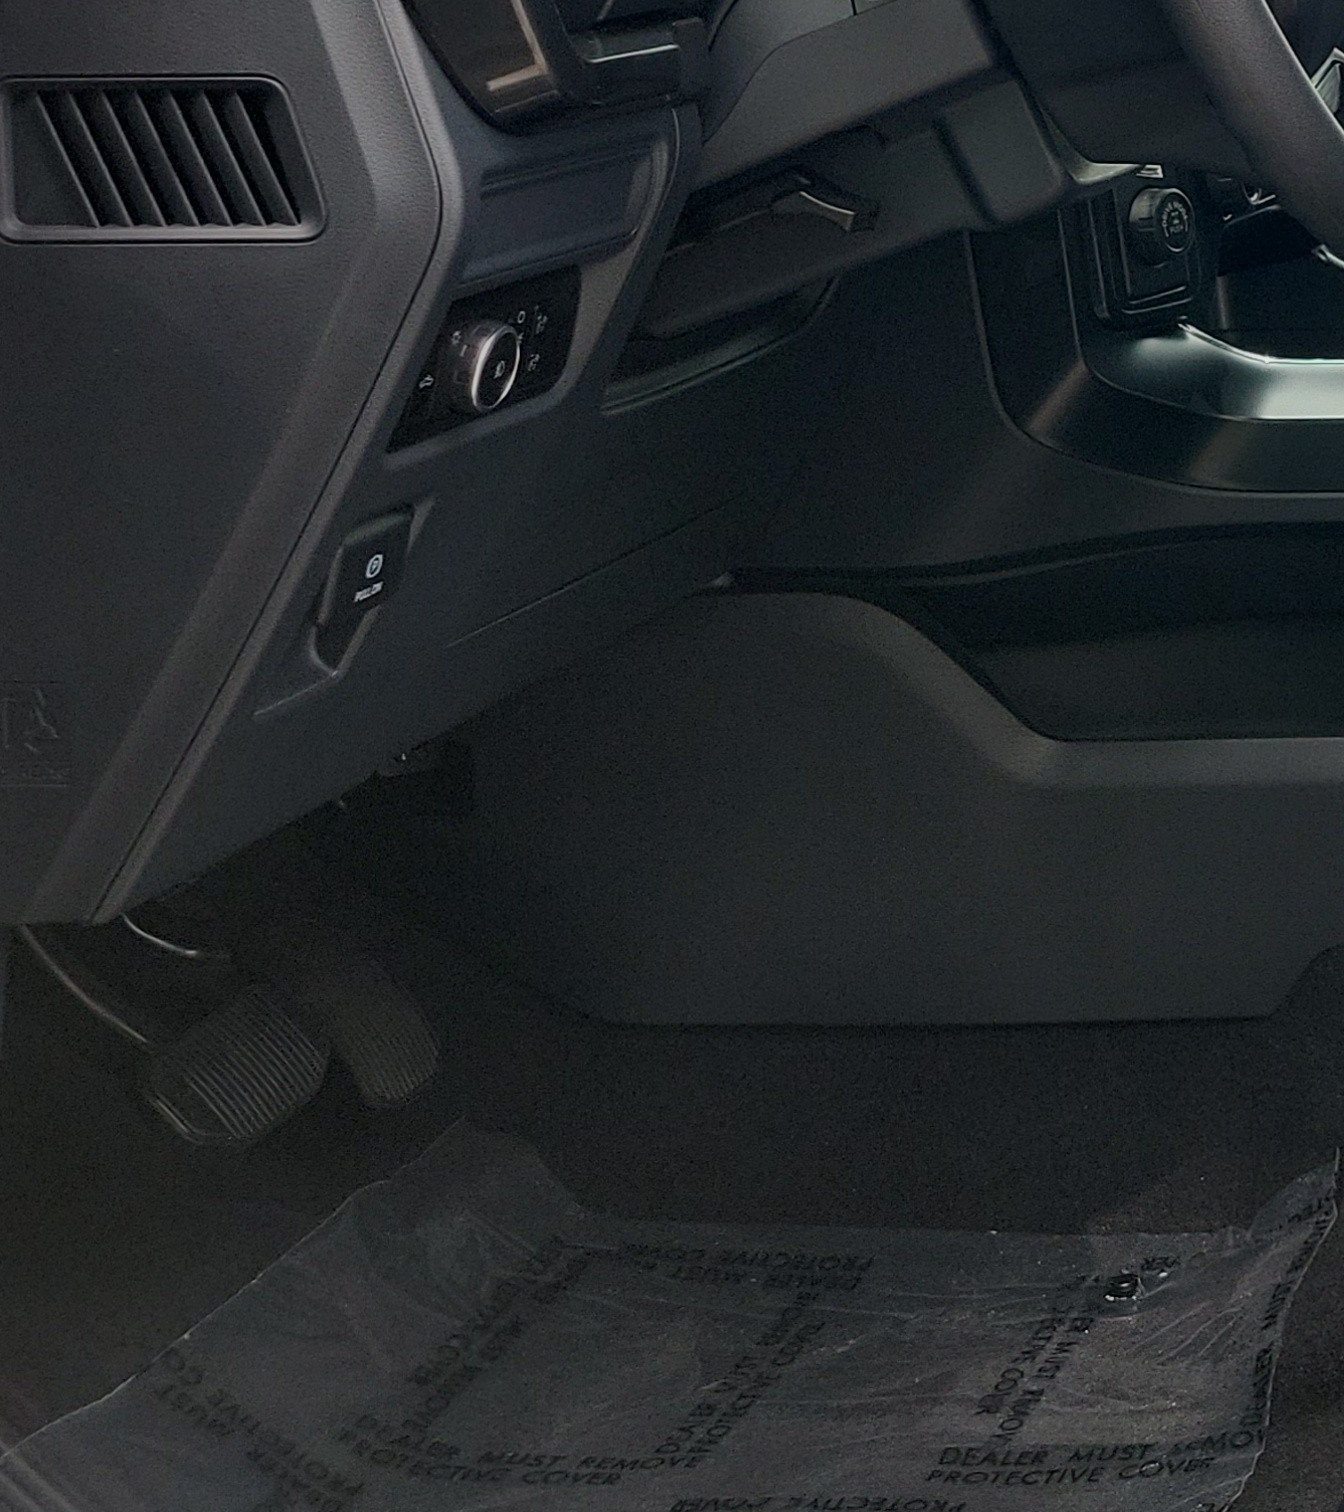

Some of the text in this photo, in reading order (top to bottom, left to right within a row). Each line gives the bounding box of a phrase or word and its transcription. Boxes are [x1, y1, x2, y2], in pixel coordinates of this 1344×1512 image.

[937, 1445, 1049, 1467] DEALER
[1067, 1441, 1158, 1464] MUST
[521, 1468, 623, 1487] COVER
[924, 1465, 1106, 1487] PROTECTIVE
